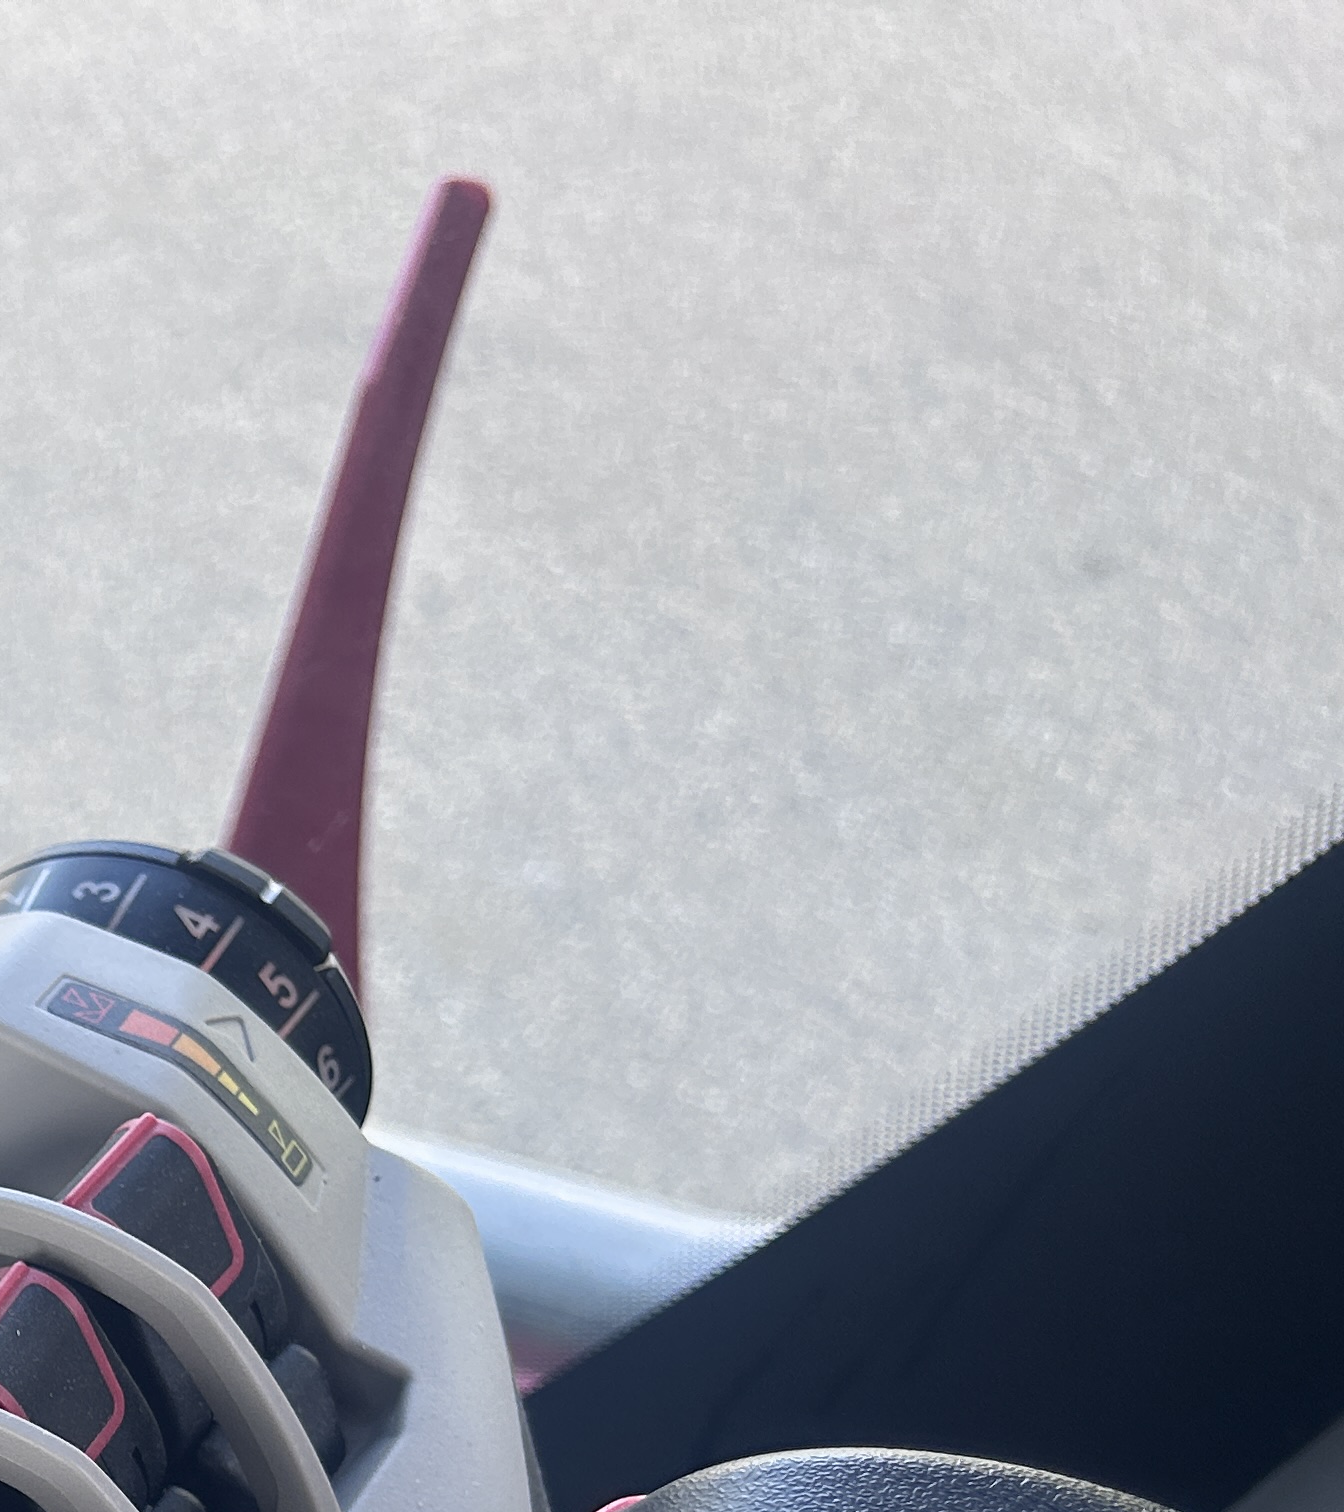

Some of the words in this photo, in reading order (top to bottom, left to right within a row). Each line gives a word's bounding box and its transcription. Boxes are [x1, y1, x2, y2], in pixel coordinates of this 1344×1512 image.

[72, 880, 121, 903] 3
[174, 904, 221, 940] 4
[258, 961, 299, 1008] 5
[316, 1044, 340, 1090] 6
